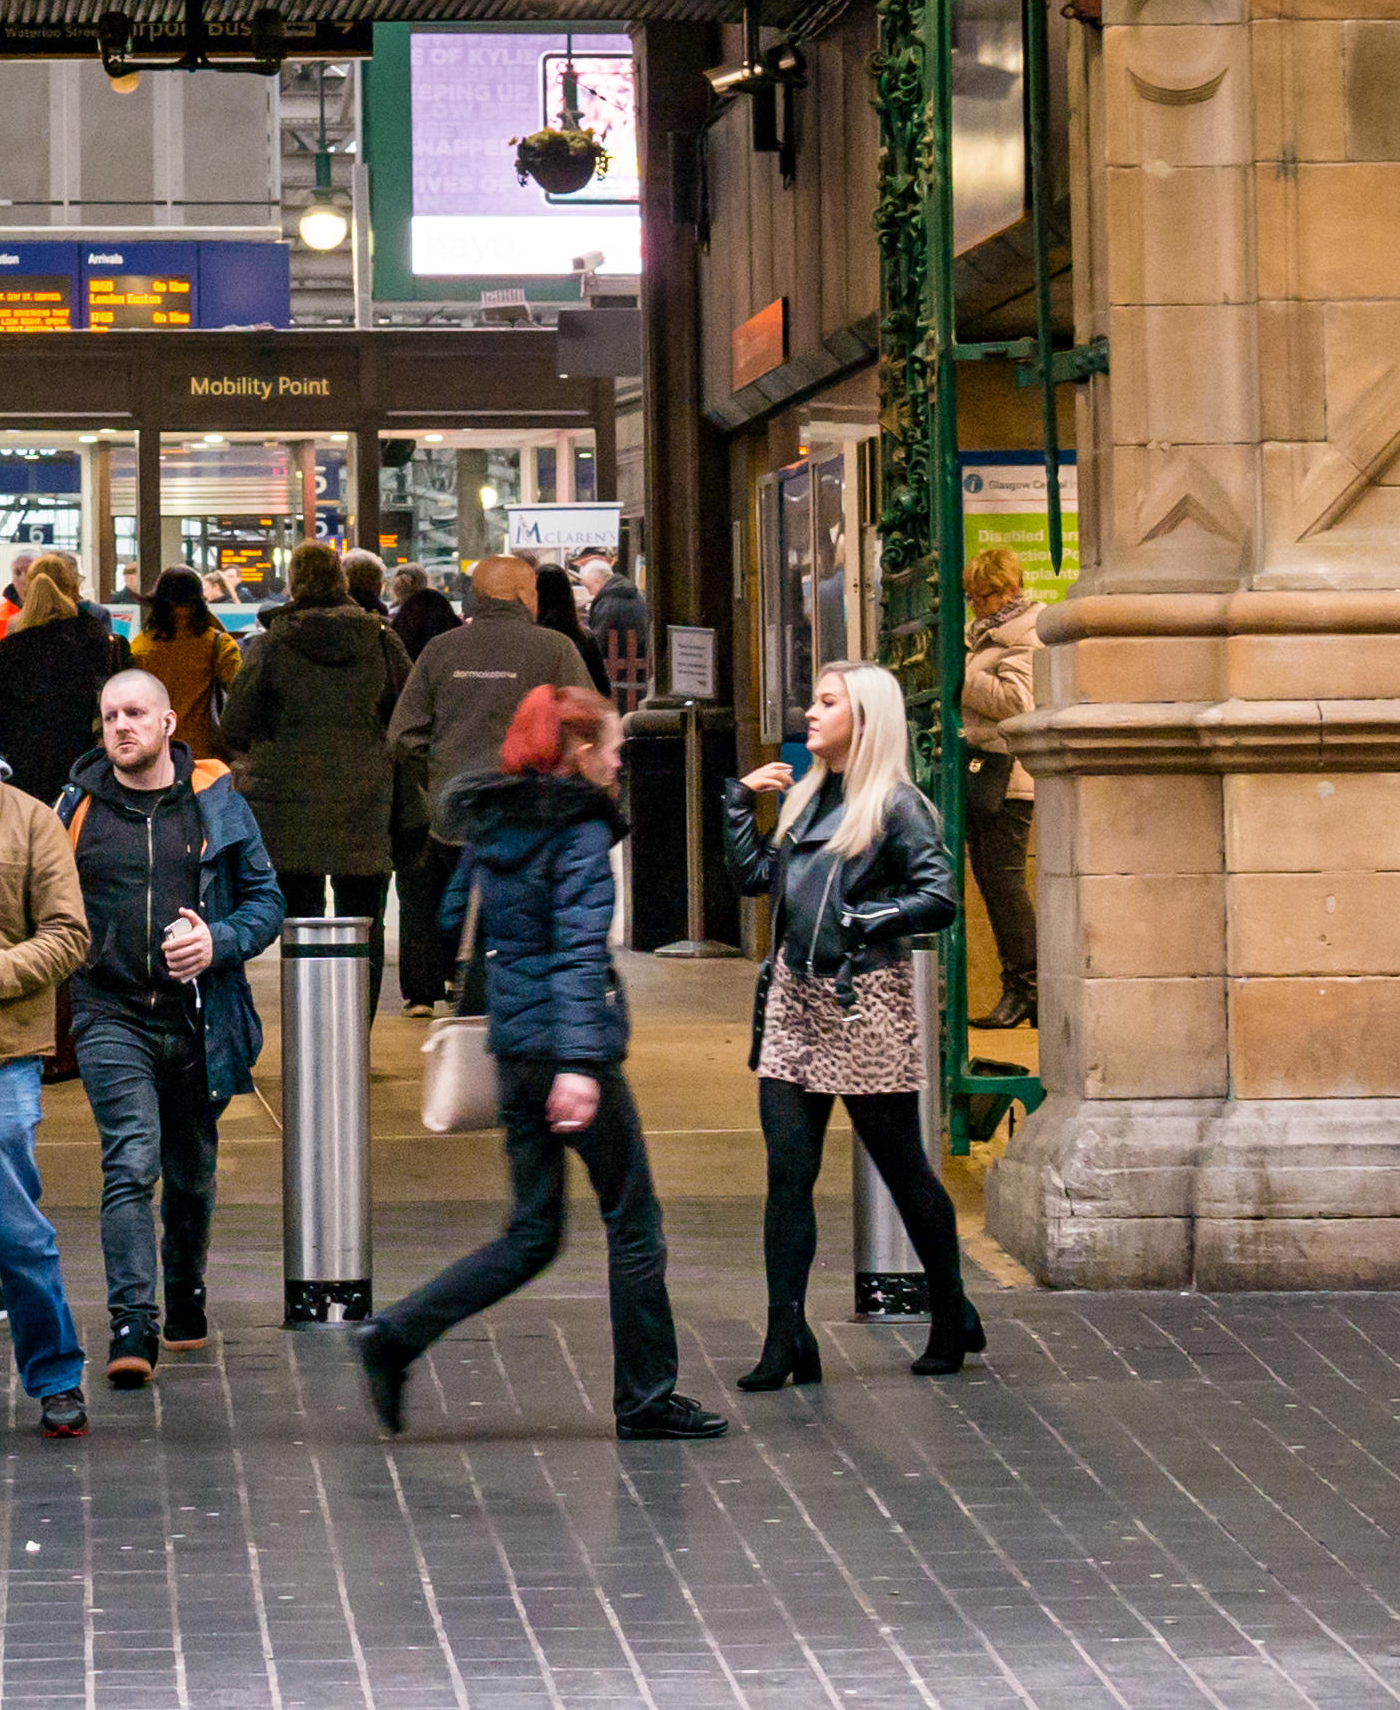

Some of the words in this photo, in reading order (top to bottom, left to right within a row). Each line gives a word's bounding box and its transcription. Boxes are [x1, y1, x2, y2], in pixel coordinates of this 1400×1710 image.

[88, 253, 123, 265] Arrivals
[190, 376, 273, 400] Mobility
[279, 376, 329, 396] Point
[978, 530, 1044, 543] Disabled
